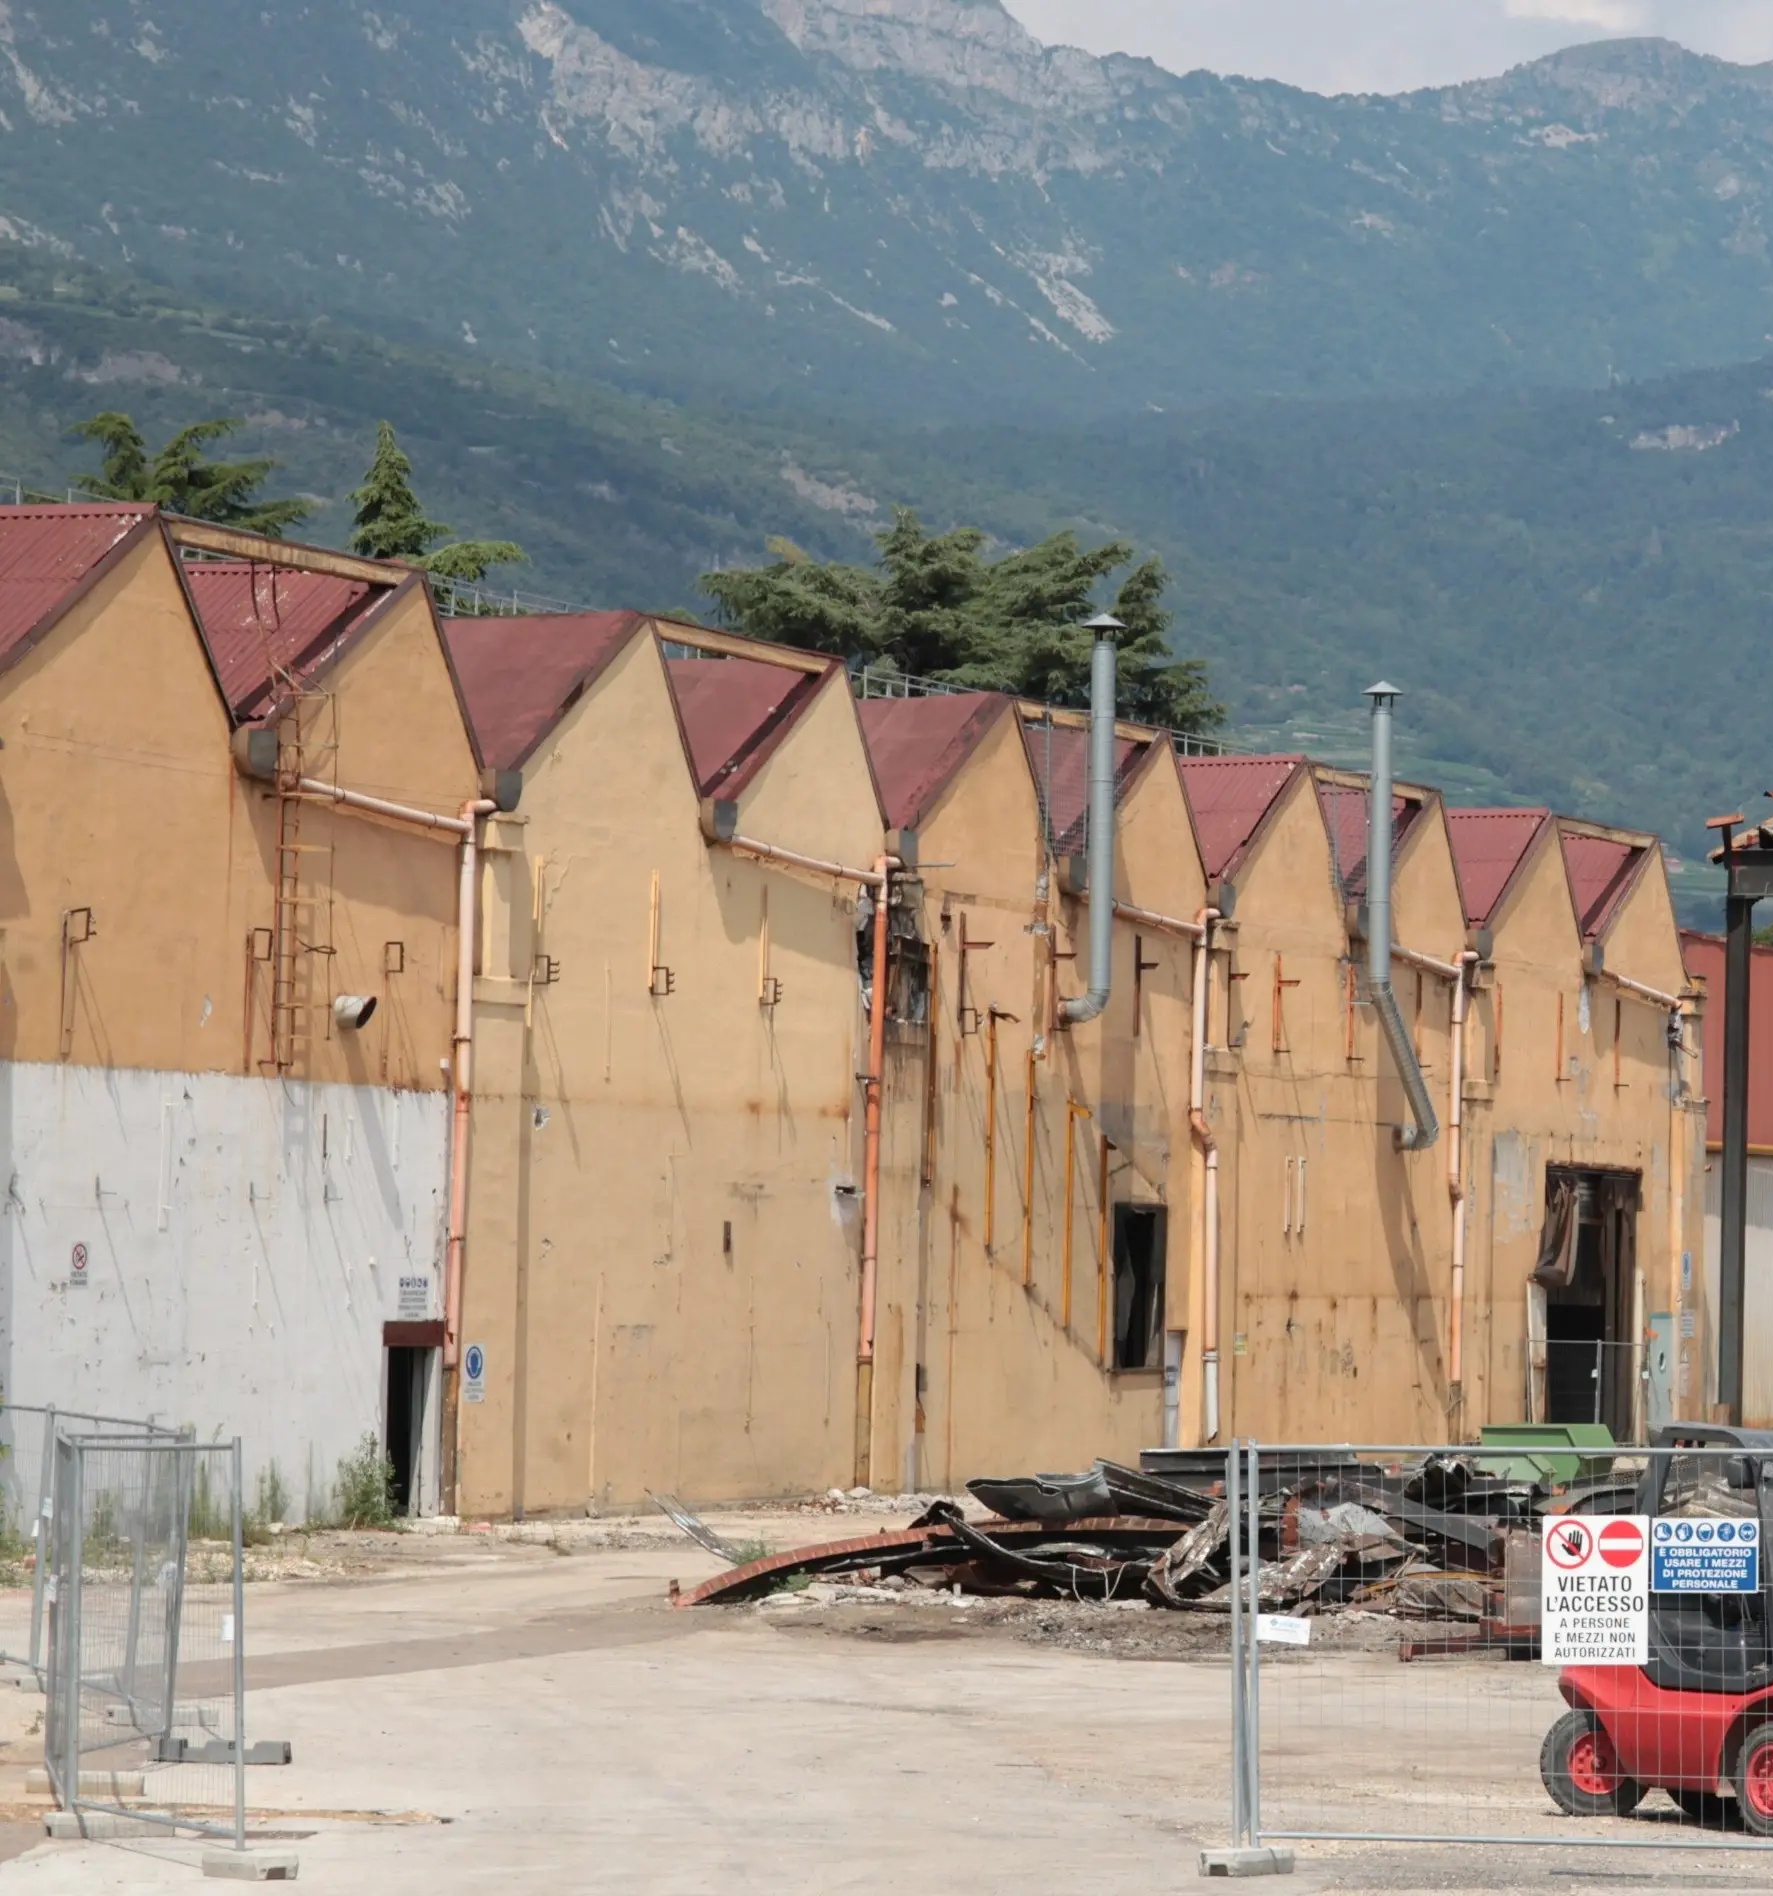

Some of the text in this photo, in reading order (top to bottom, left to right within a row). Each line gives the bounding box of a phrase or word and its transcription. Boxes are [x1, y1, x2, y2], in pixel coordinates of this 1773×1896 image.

[1659, 1546, 1752, 1558] È OBBLIGATORIO
[1664, 1559, 1746, 1568] USARE I MEZZI
[1662, 1569, 1748, 1579] DI PROTEZIONE
[1557, 1576, 1632, 1593] VIETATO
[1671, 1580, 1738, 1589] PERSONALE
[1546, 1596, 1644, 1613] L'ACCESSO
[1559, 1617, 1630, 1629] A PERSONE
[1554, 1632, 1636, 1644] E MEZZI NON
[1554, 1646, 1636, 1659] AUTORIZZATI
